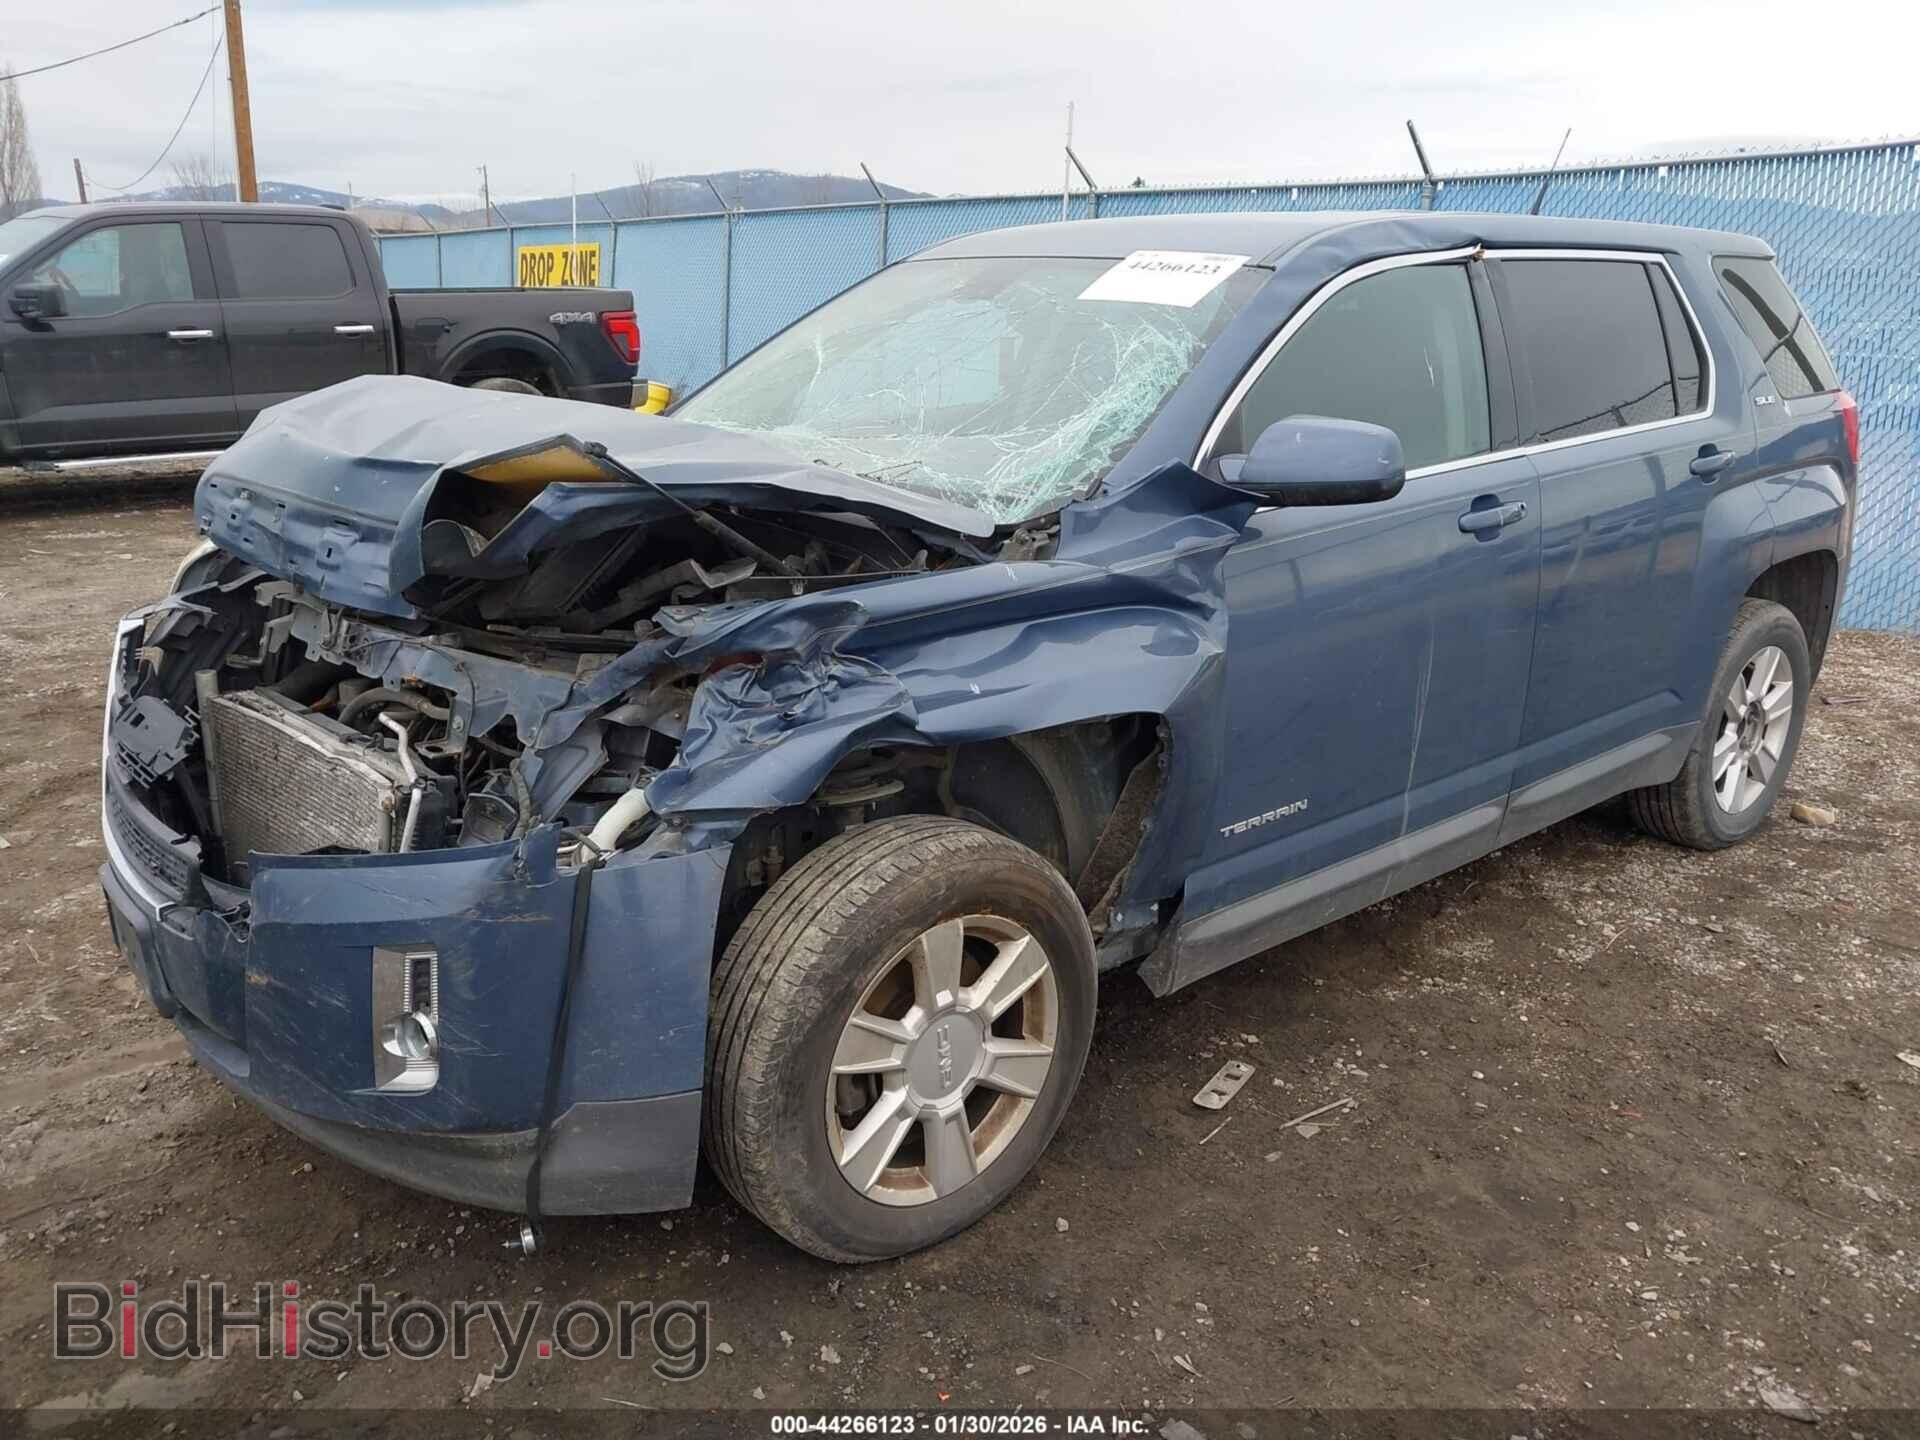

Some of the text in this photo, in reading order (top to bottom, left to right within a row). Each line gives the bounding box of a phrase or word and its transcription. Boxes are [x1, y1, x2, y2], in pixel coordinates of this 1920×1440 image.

[520, 250, 597, 287] DROP ZONE
[1220, 798, 1308, 838] TERRAIN
[937, 1024, 952, 1089] GMC
